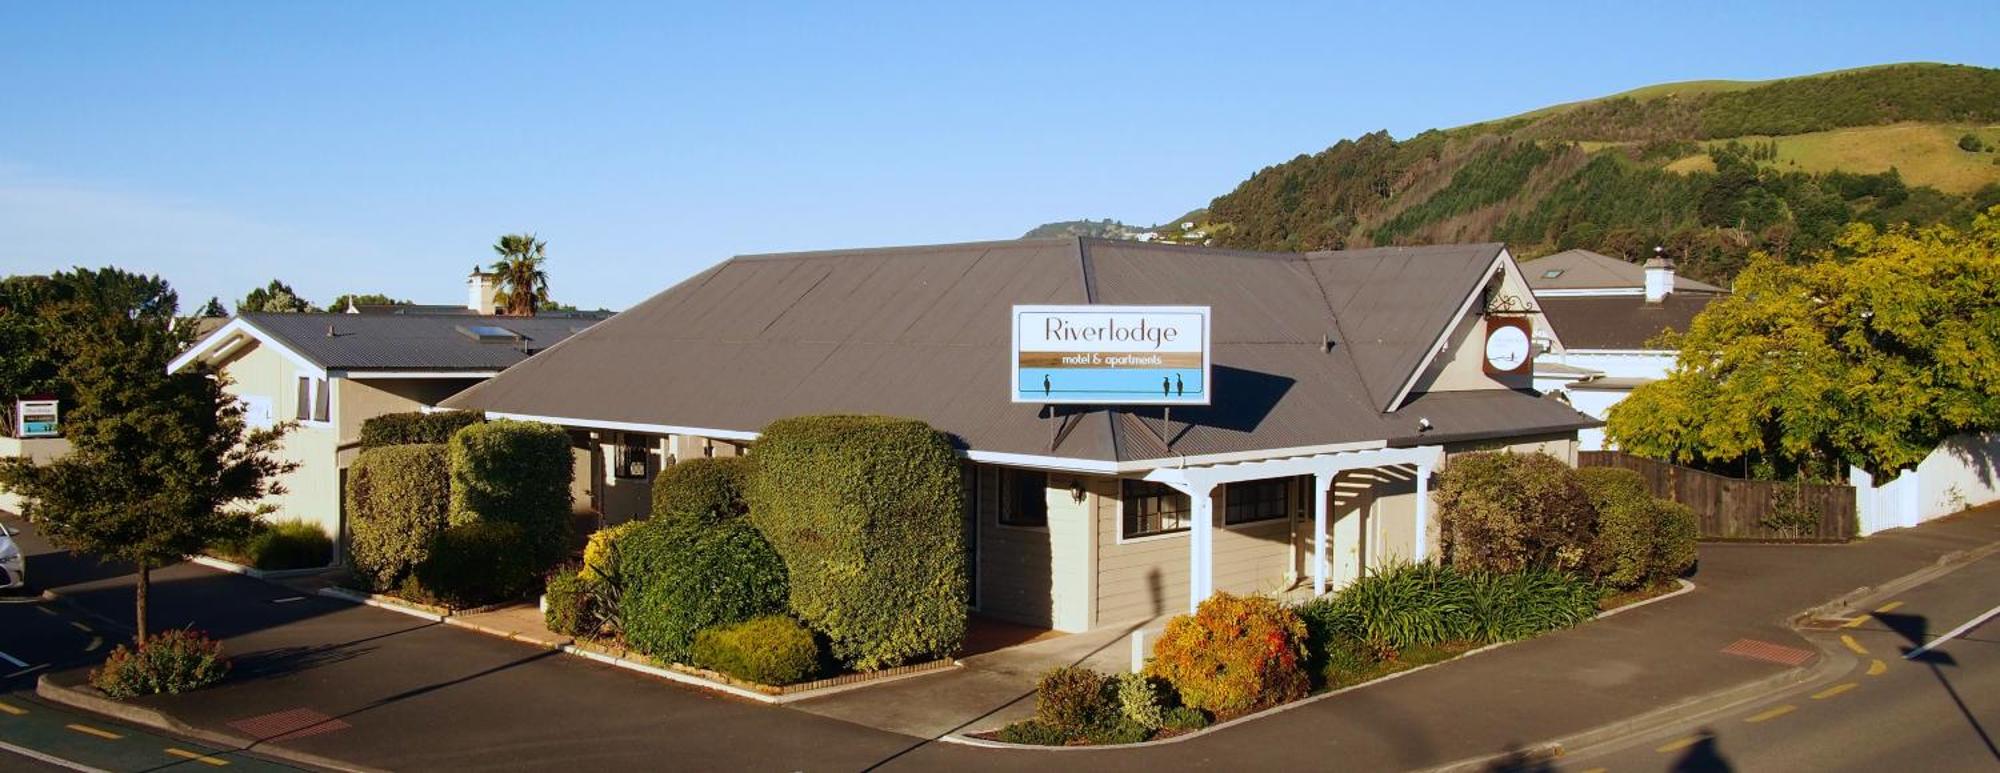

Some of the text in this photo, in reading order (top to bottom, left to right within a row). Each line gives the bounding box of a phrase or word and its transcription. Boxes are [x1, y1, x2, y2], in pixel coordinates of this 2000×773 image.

[1045, 317, 1178, 350] Riverlodge
[1062, 353, 1163, 368] motel & apartments
